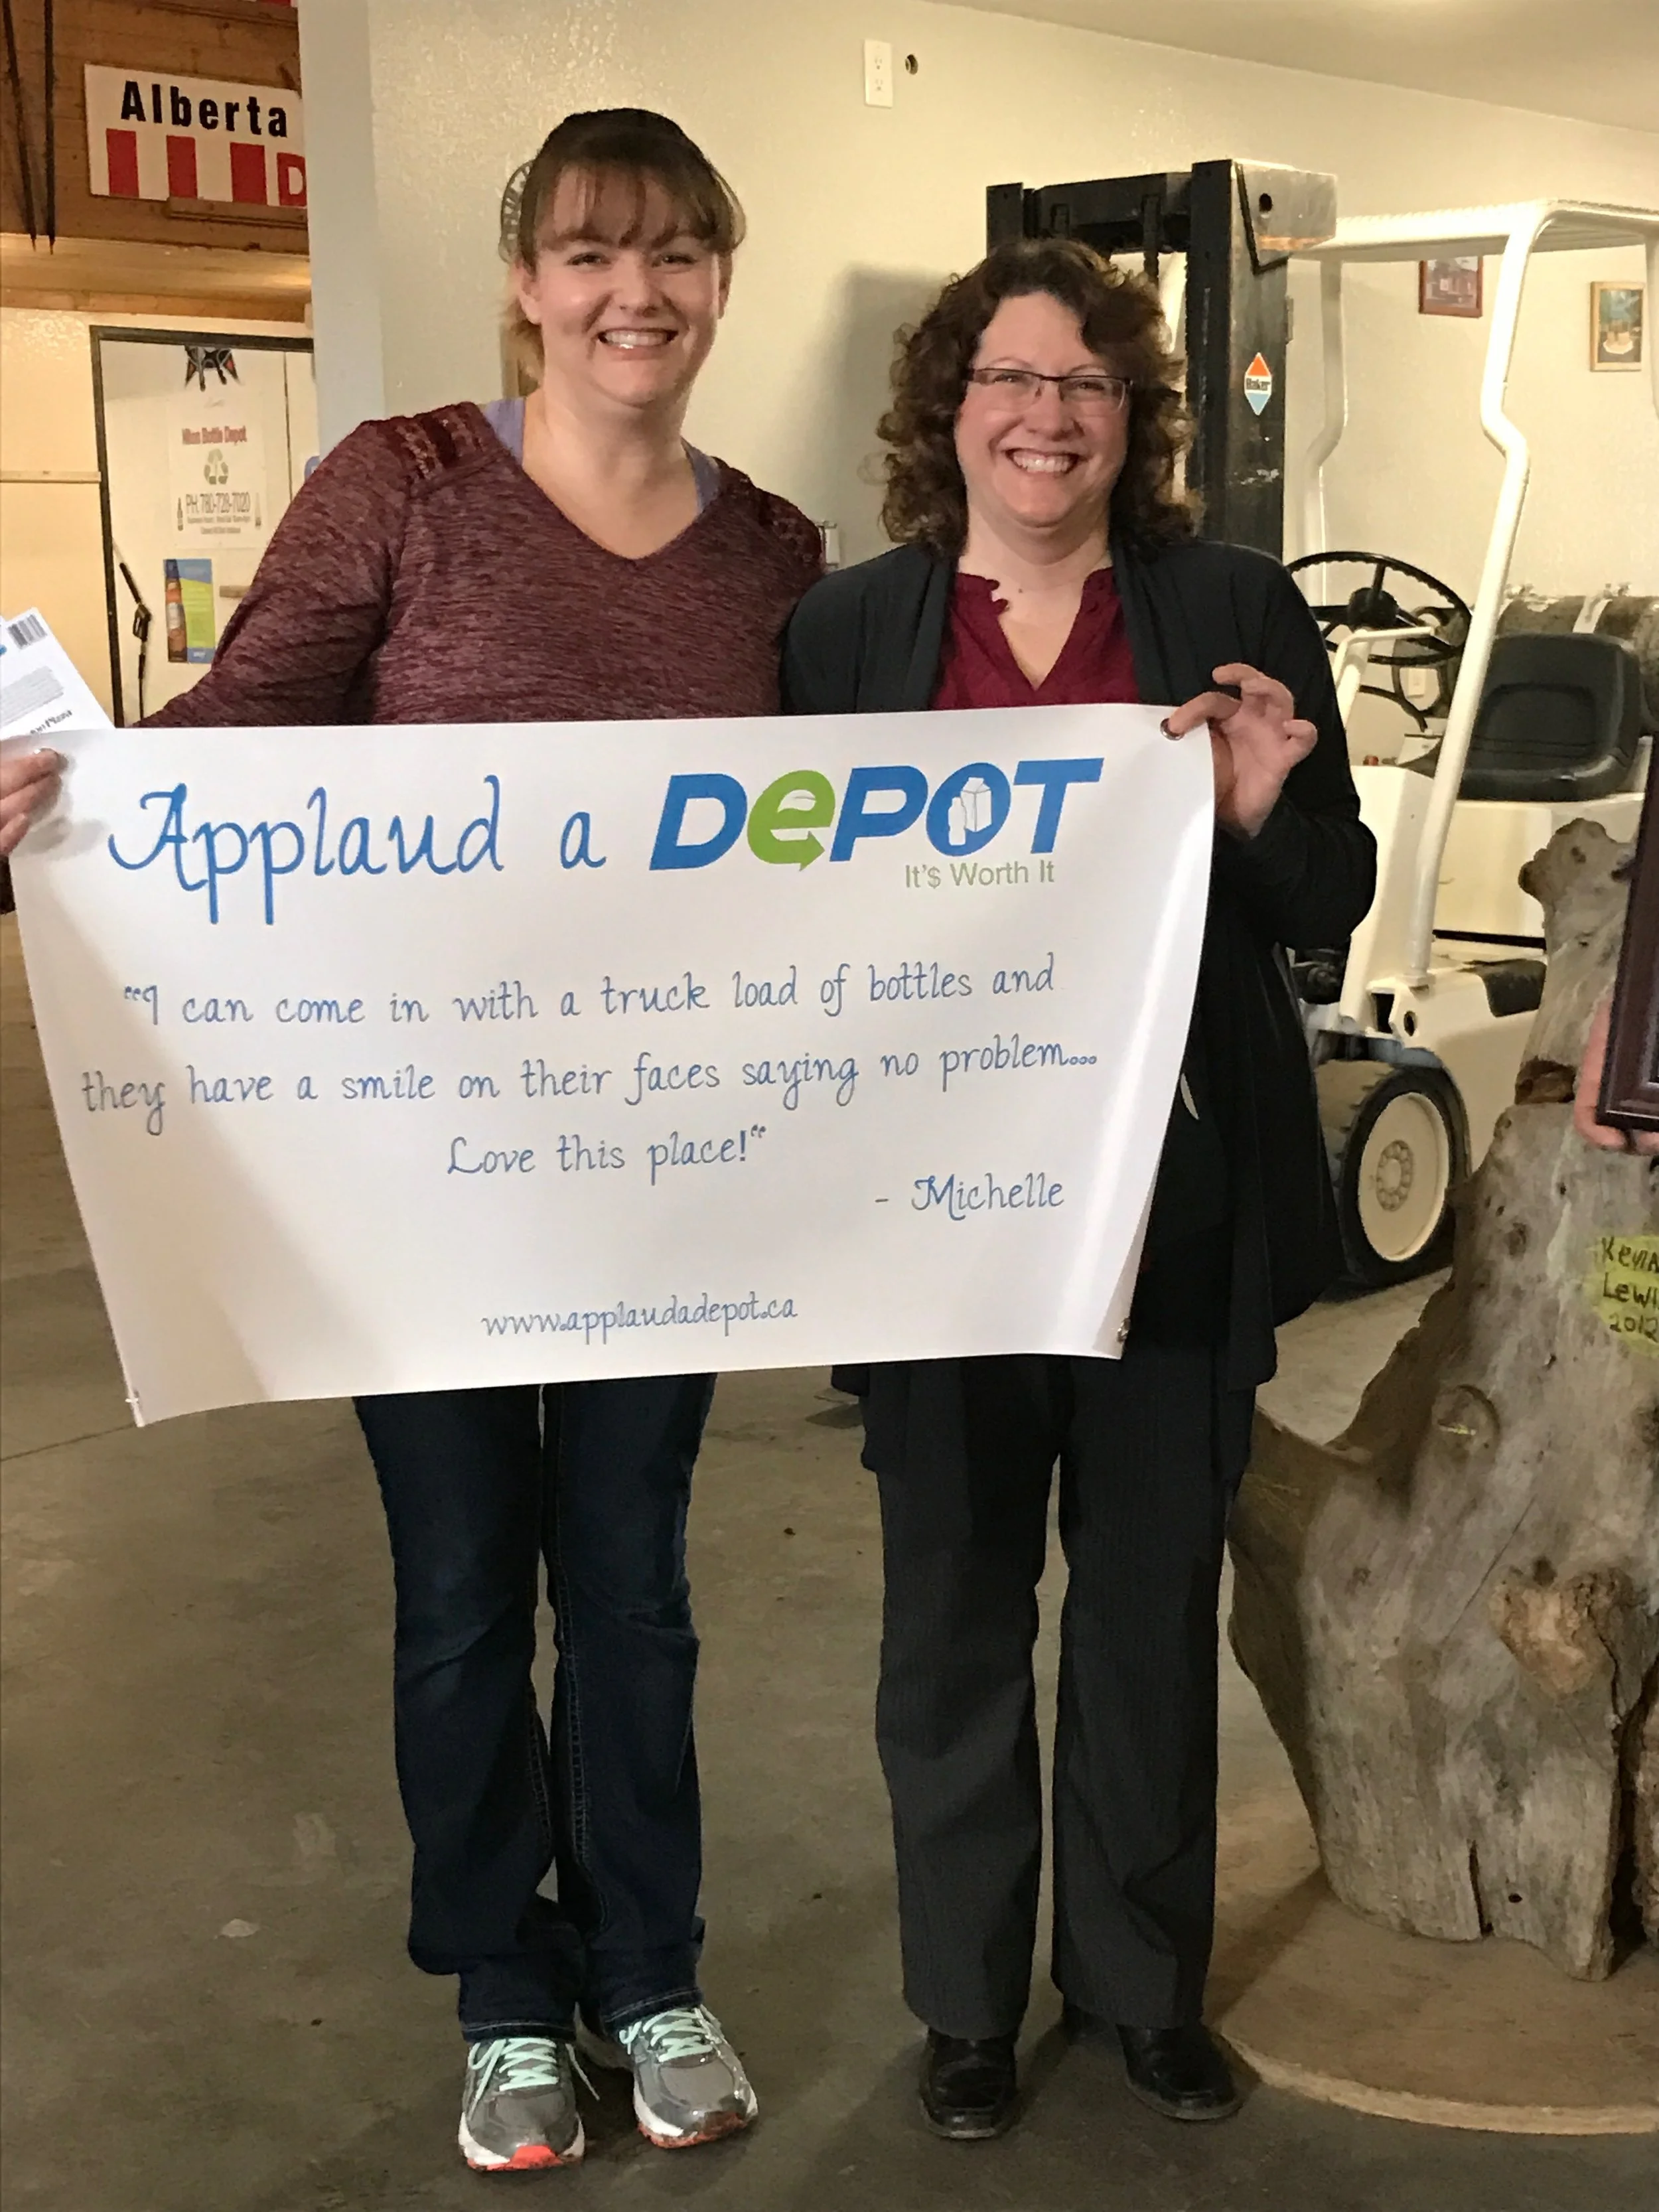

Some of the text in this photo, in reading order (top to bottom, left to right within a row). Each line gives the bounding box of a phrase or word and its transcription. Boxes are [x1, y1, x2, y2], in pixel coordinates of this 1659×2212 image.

[121, 80, 288, 138] Alberta
[106, 773, 506, 927] Applaud
[559, 810, 608, 871] a
[948, 861, 1029, 887] Worth
[1039, 859, 1056, 883] It
[181, 997, 255, 1024] can
[275, 997, 366, 1024] come
[388, 992, 431, 1024] in
[451, 979, 540, 1023] with
[559, 991, 582, 1017] a
[599, 970, 711, 1015] truck
[731, 964, 799, 1009] load
[819, 962, 852, 1018] of
[867, 960, 974, 1003] bottles
[991, 950, 1055, 994] and
[80, 1069, 167, 1138] they
[184, 1063, 275, 1105] have
[296, 1074, 320, 1101] a
[340, 1063, 437, 1100] smile
[457, 1074, 502, 1100] on
[519, 1057, 613, 1099] their
[623, 1051, 721, 1107] faces
[741, 1051, 861, 1112] saying
[879, 1051, 920, 1078] no
[446, 1135, 537, 1175] Love
[555, 1133, 626, 1173] this
[910, 1171, 1066, 1222] Michelle
[480, 1290, 799, 1346] www.applaudadepot.ca
[1609, 1311, 1658, 1343] 2012
